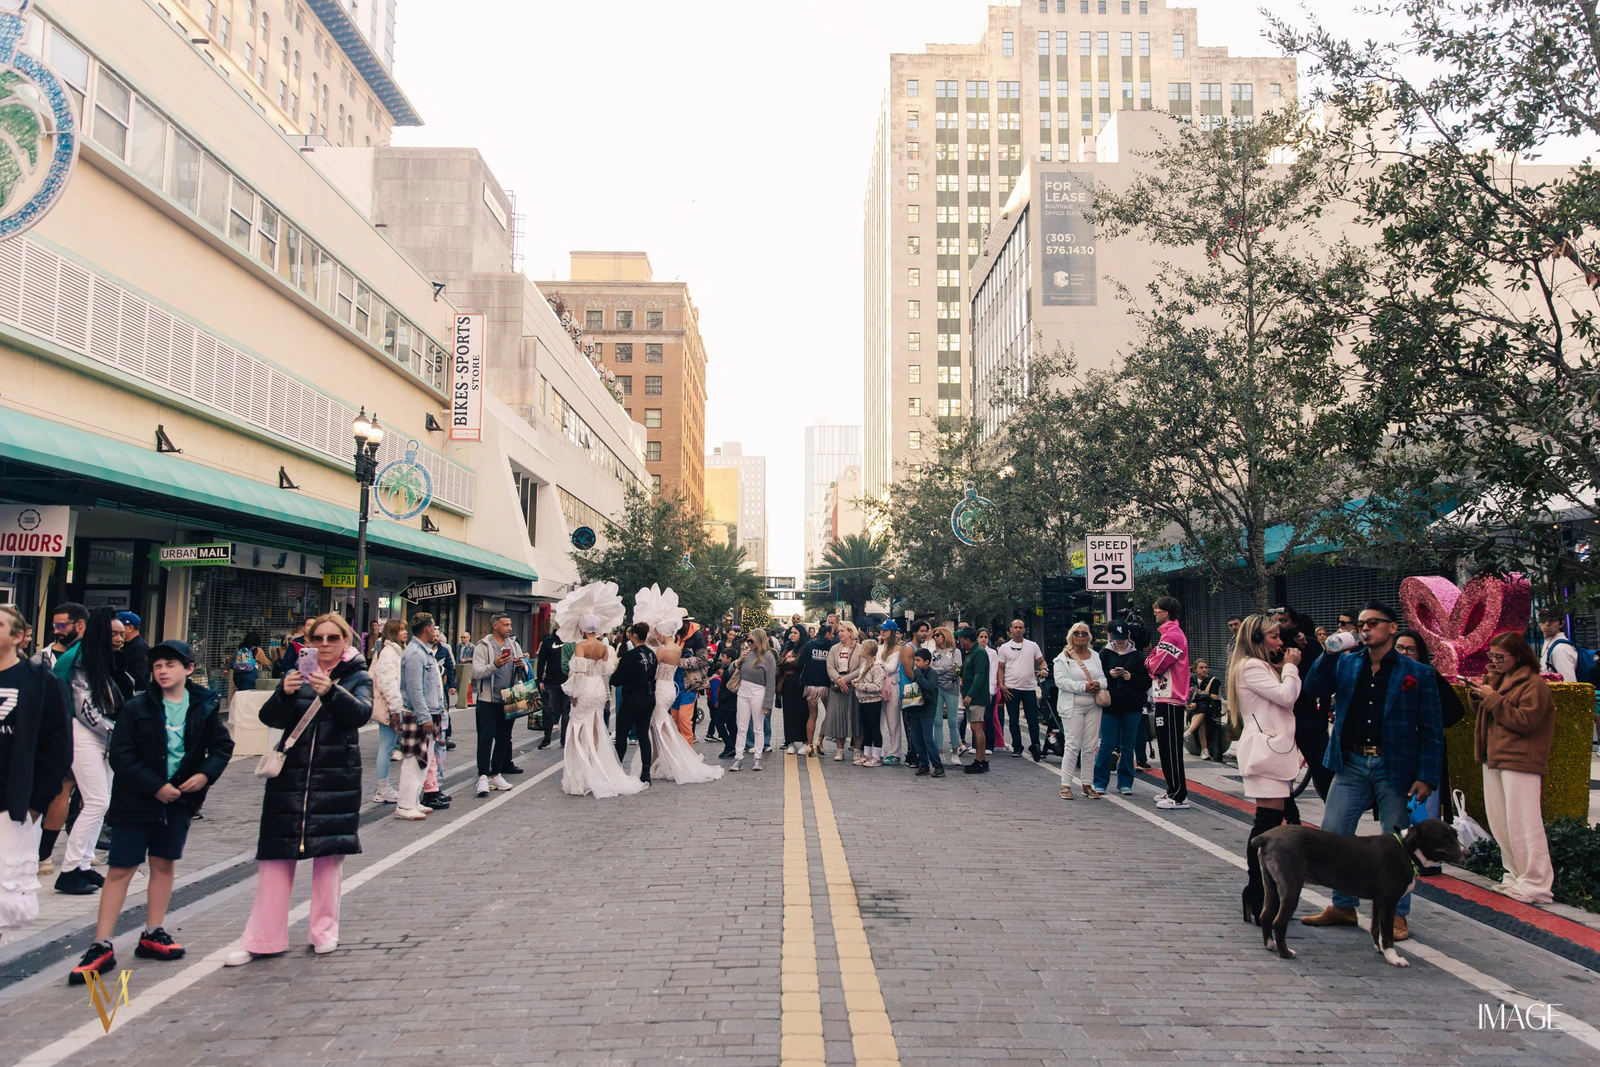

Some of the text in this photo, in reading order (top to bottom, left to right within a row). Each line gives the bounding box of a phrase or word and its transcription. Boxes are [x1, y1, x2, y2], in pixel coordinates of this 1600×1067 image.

[1044, 181, 1072, 191] FOR
[1044, 192, 1086, 202] LEASE
[1045, 233, 1076, 243] (305)
[1046, 246, 1095, 255] 576.1430
[456, 316, 471, 374] SPORTS
[471, 354, 480, 391] STORE
[454, 382, 468, 426] BIKES
[0, 532, 63, 553] IQUORS
[1090, 540, 1128, 550] SPEED
[161, 547, 228, 559] URBAN MAIL
[1094, 553, 1124, 562] LIMIT
[332, 566, 357, 574] COMPUTE
[1092, 564, 1127, 585] 25
[330, 575, 355, 585] REPAI
[407, 582, 453, 600] SMOKE SHOP
